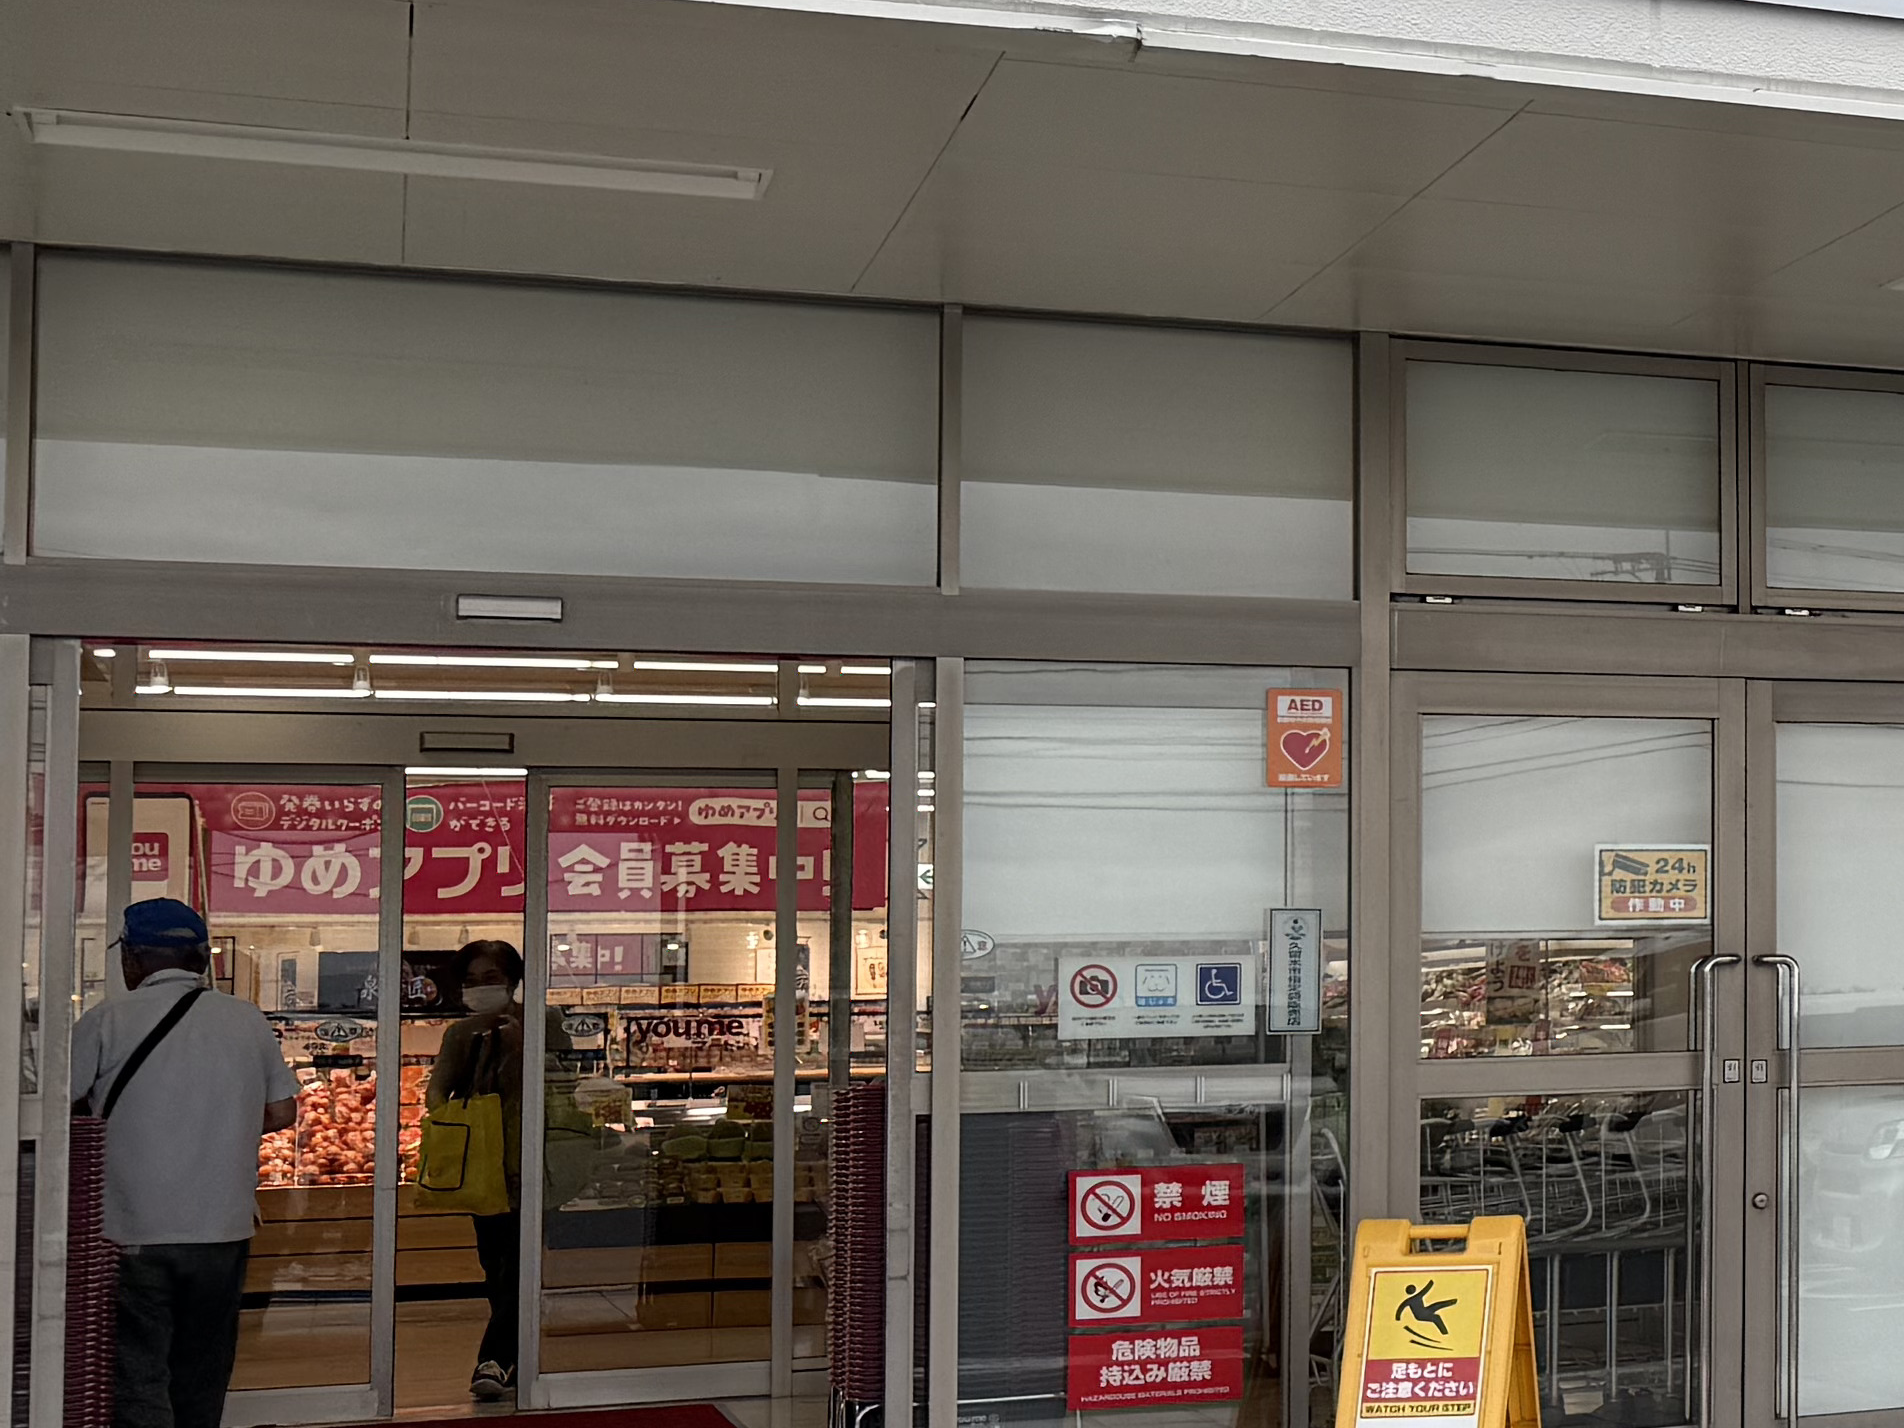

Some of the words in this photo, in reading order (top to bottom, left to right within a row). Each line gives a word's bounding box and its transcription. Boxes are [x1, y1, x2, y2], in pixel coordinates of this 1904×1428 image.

[1287, 698, 1324, 712] AED
[449, 816, 511, 831] ができる
[131, 842, 160, 855] ou
[1654, 857, 1697, 874] 24h
[1610, 878, 1698, 894] 防犯カメラ
[1154, 1213, 1172, 1222] NO
[1149, 1266, 1234, 1289] 火気厳禁
[1111, 1336, 1200, 1362] 危険物品
[1099, 1360, 1213, 1388] 持込み厳禁
[1391, 1362, 1454, 1379] 足もとに
[1366, 1381, 1474, 1399] ご注意ください
[1365, 1404, 1406, 1414] WATCH
[1408, 1403, 1440, 1414] YOUR
[1441, 1402, 1472, 1413] STEP
